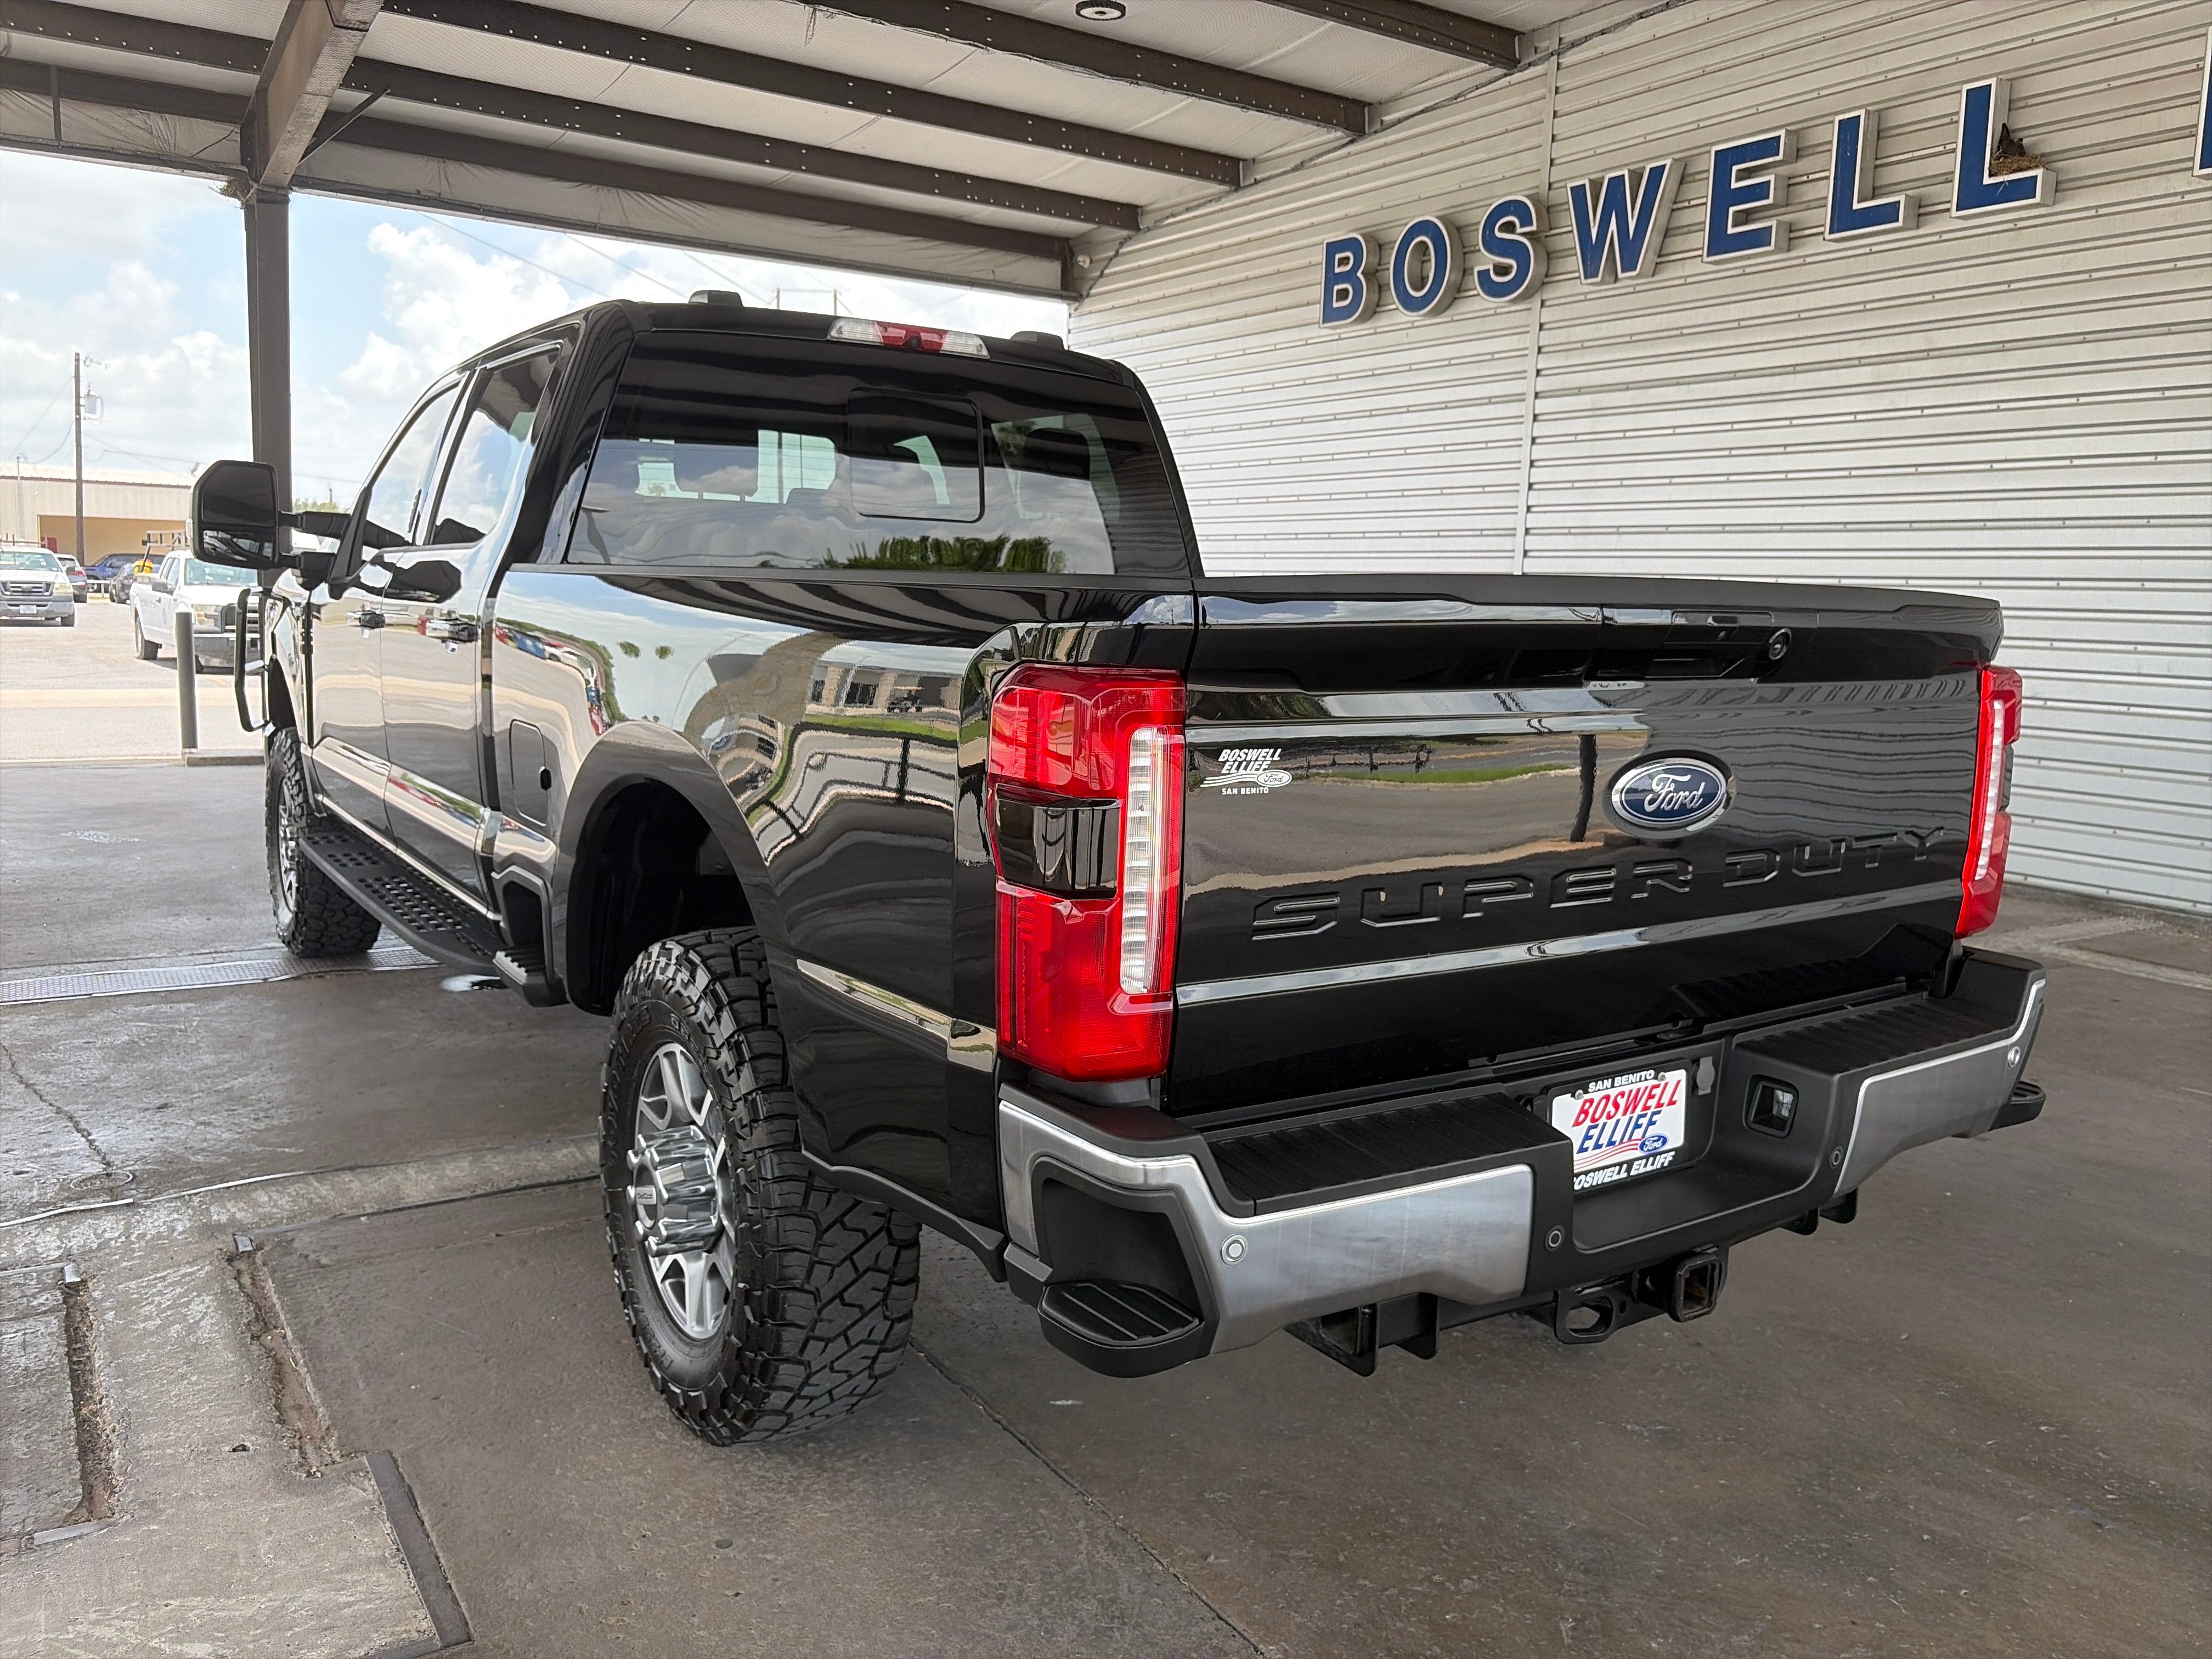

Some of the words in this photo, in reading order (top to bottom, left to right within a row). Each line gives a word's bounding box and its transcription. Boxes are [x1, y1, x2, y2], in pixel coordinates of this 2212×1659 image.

[1319, 77, 2055, 329] BOSWELL
[1218, 748, 1282, 761] BOSWELL
[1221, 761, 1271, 774] ELLIFF
[1263, 774, 1283, 783] Ford
[1644, 774, 1703, 813] Ford
[1251, 858, 1693, 941] SUPER
[1723, 826, 1945, 889] DUTY
[1588, 1078, 1611, 1092] SAN
[1613, 1069, 1655, 1086] BENITO
[1572, 1079, 1682, 1127] BOSWELL
[1576, 1109, 1663, 1154] ELLIFF
[1644, 1136, 1664, 1151] Ford
[1573, 1164, 1629, 1190] OSWELL
[1630, 1151, 1675, 1176] ELLIFF
